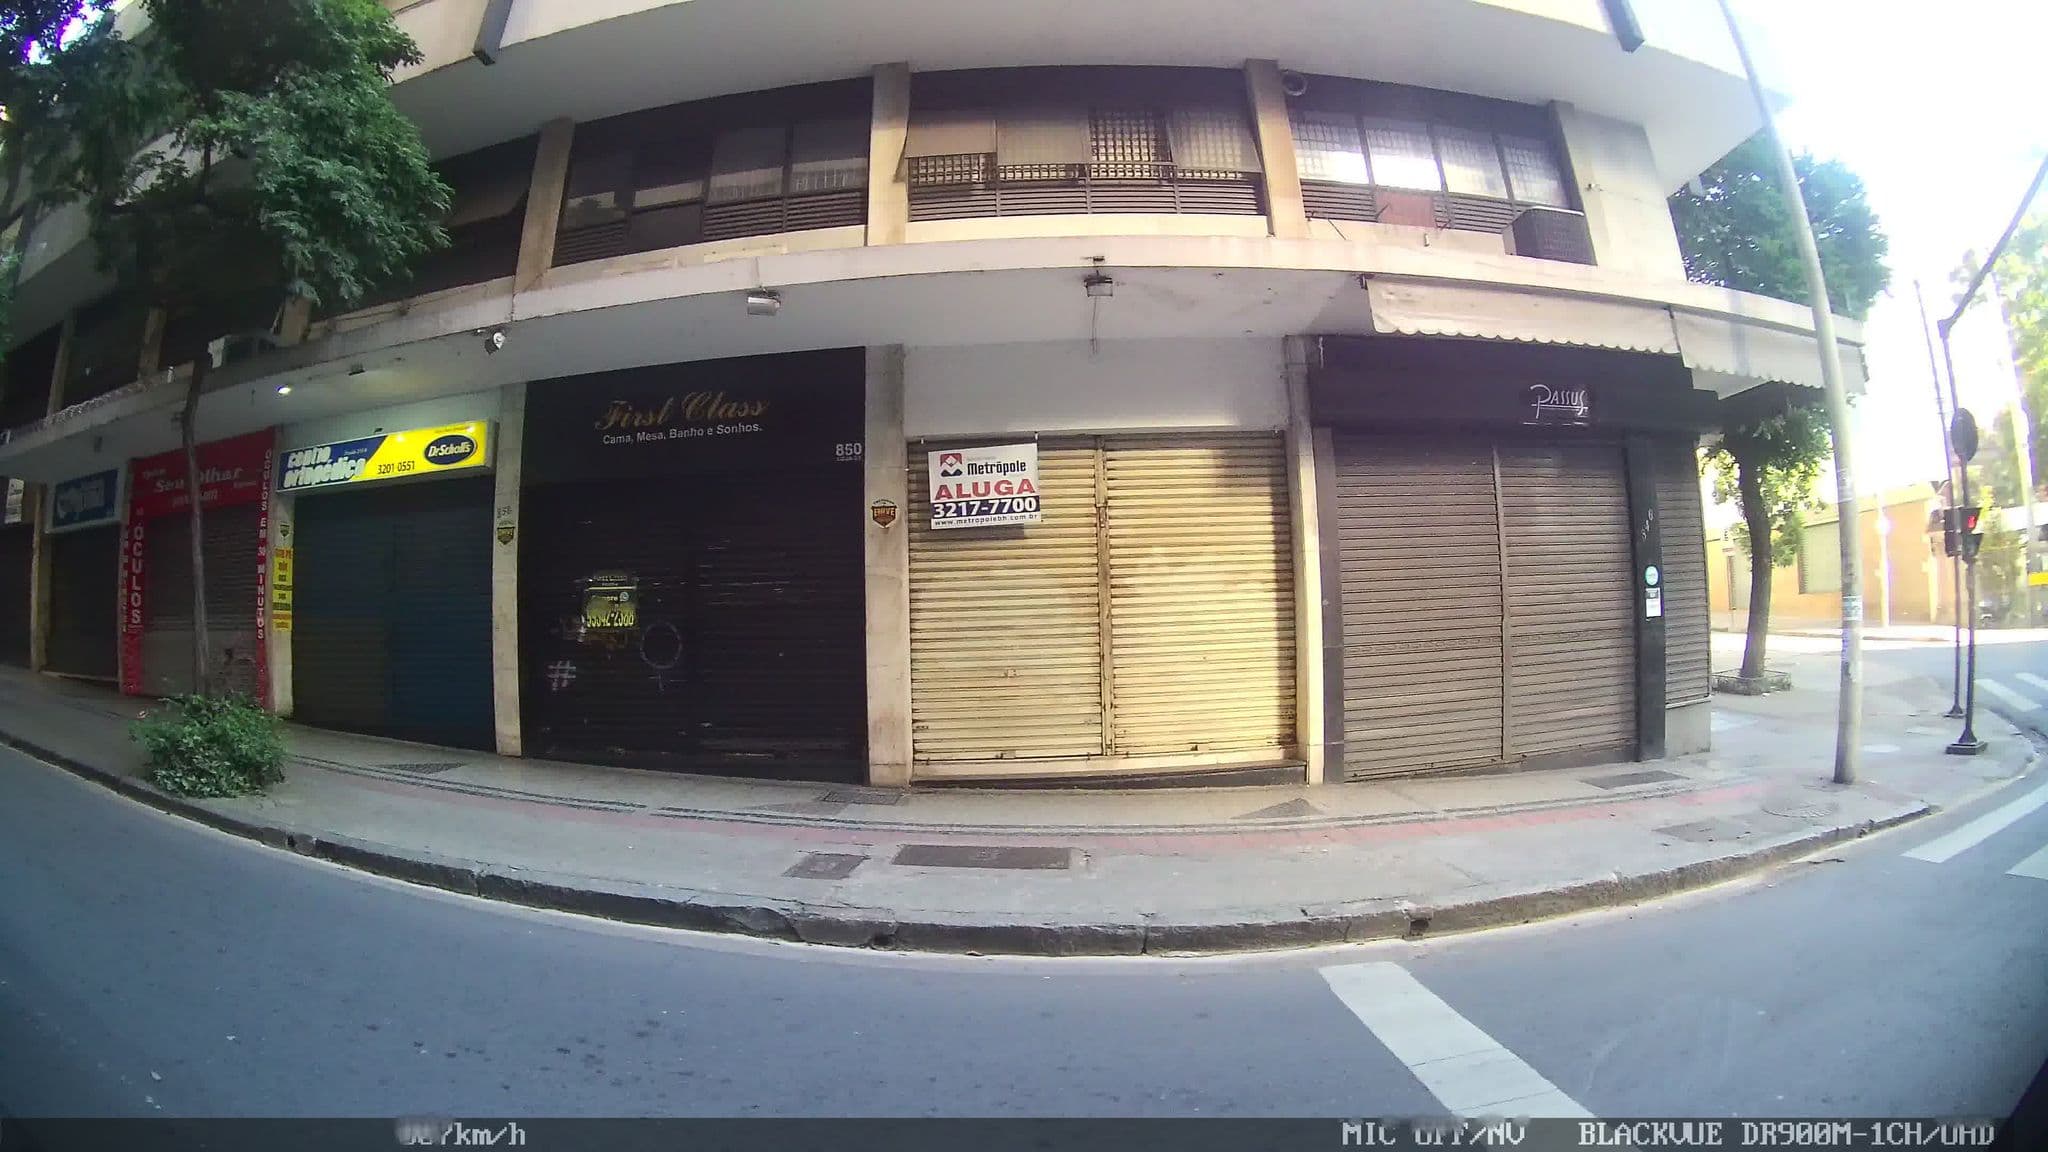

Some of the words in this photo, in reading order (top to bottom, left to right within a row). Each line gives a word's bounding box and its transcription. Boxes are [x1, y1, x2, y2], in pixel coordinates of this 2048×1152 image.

[594, 397, 675, 431] First
[681, 391, 769, 421] Class
[602, 433, 635, 446] Cama,
[669, 426, 705, 440] Banho
[706, 426, 714, 436] e
[835, 442, 863, 457] 850
[377, 462, 396, 475] 3201
[397, 460, 416, 473] 0551
[966, 460, 1027, 476] Metrópole
[934, 478, 1036, 501] ALUGA
[933, 497, 1037, 518] 3217-7700
